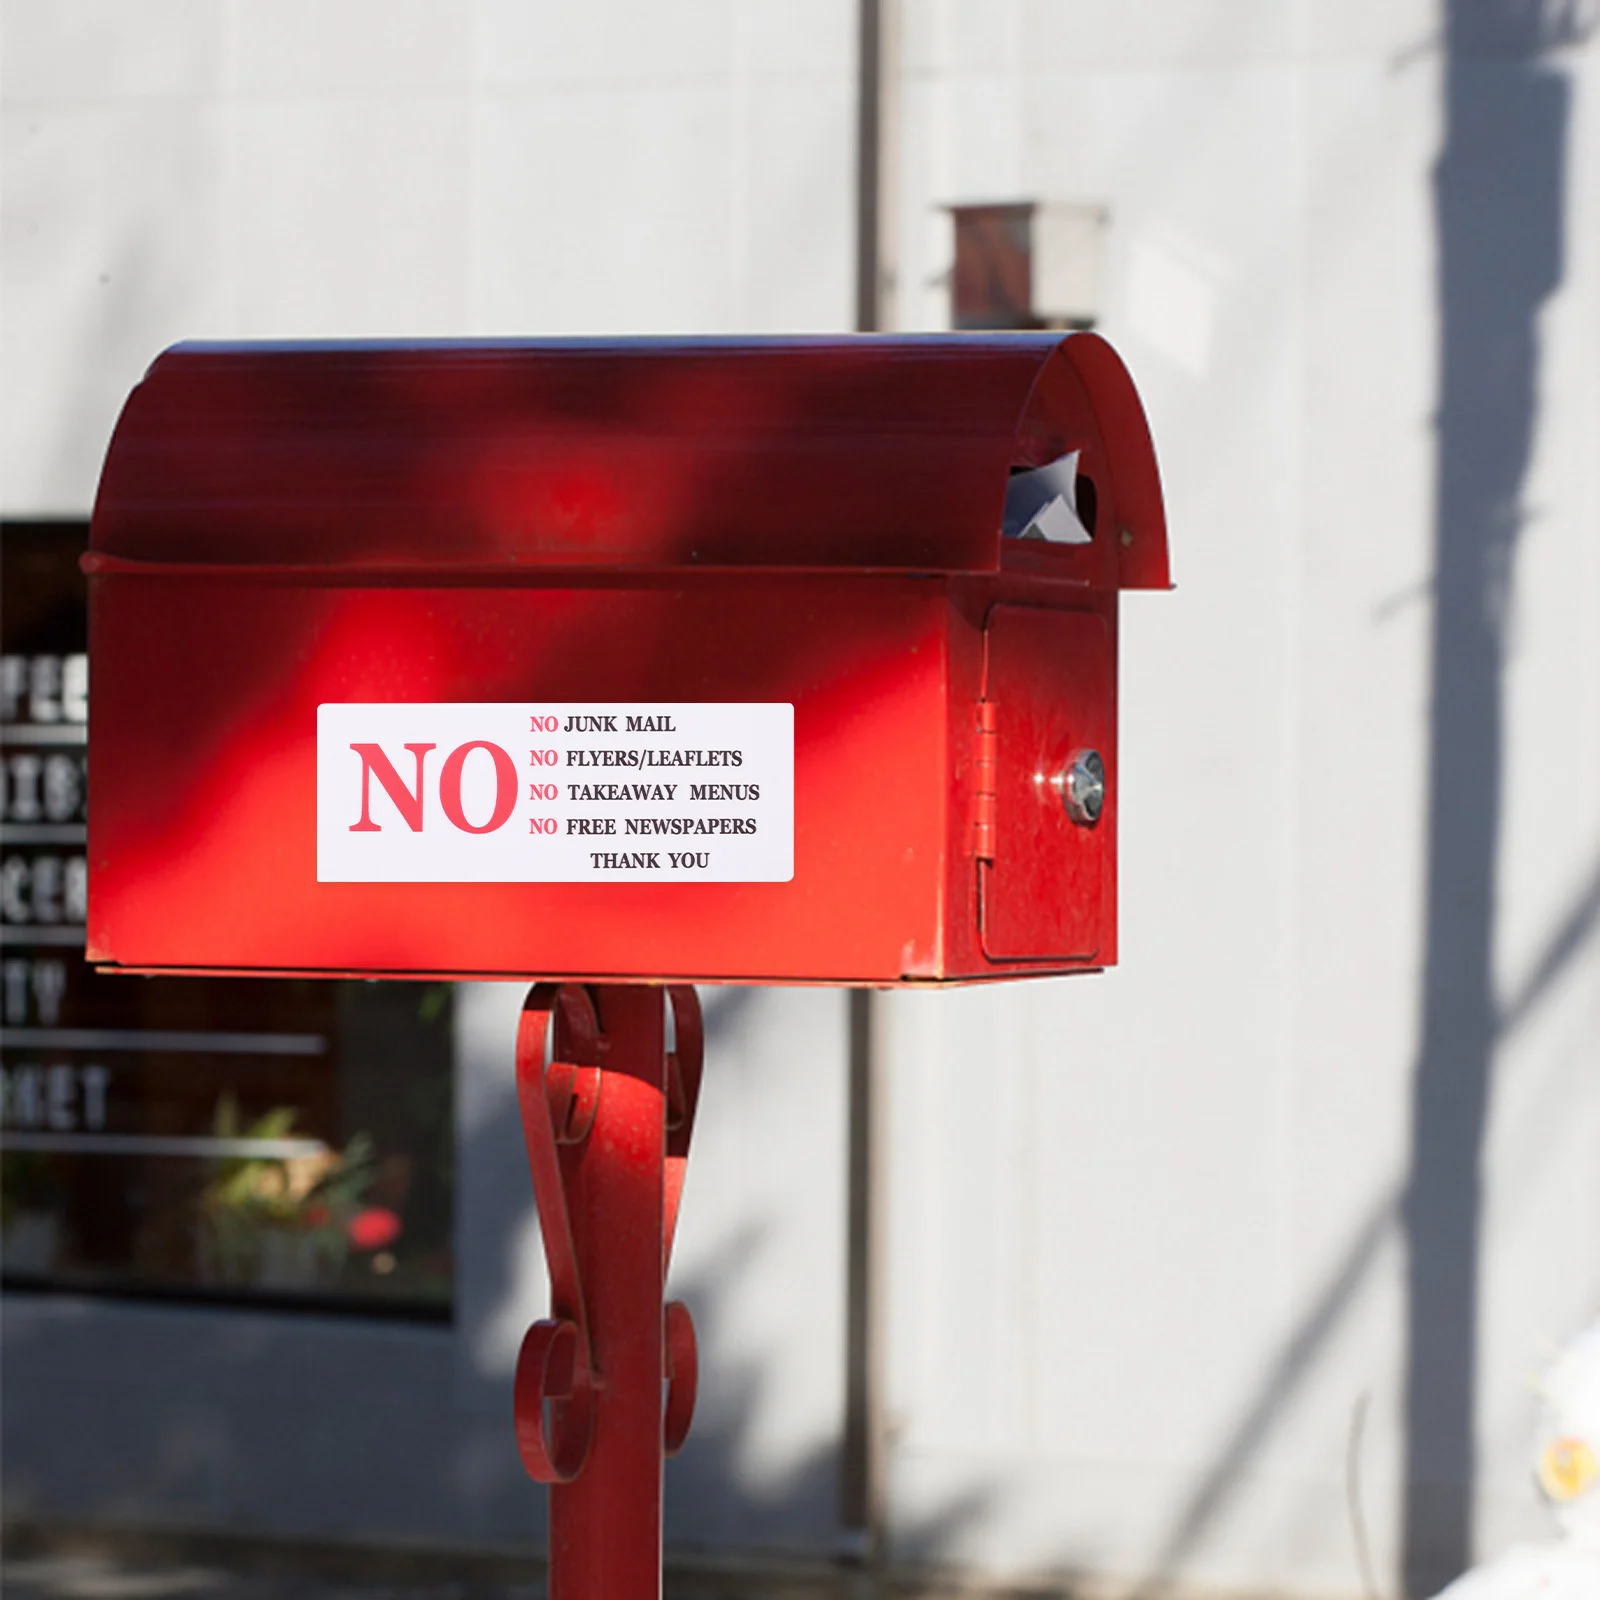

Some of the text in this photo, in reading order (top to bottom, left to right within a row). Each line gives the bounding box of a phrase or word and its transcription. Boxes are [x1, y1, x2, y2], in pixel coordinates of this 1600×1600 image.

[530, 716, 676, 732] NO JUNK MAIL
[530, 750, 742, 770] NO FLYERS/LEAFLETS
[349, 740, 518, 834] NO
[530, 784, 759, 800] NO TAKEAWAY MENUS
[529, 818, 757, 835] NO FREE NEWSPAPERS
[590, 852, 710, 868] THANK YOU
